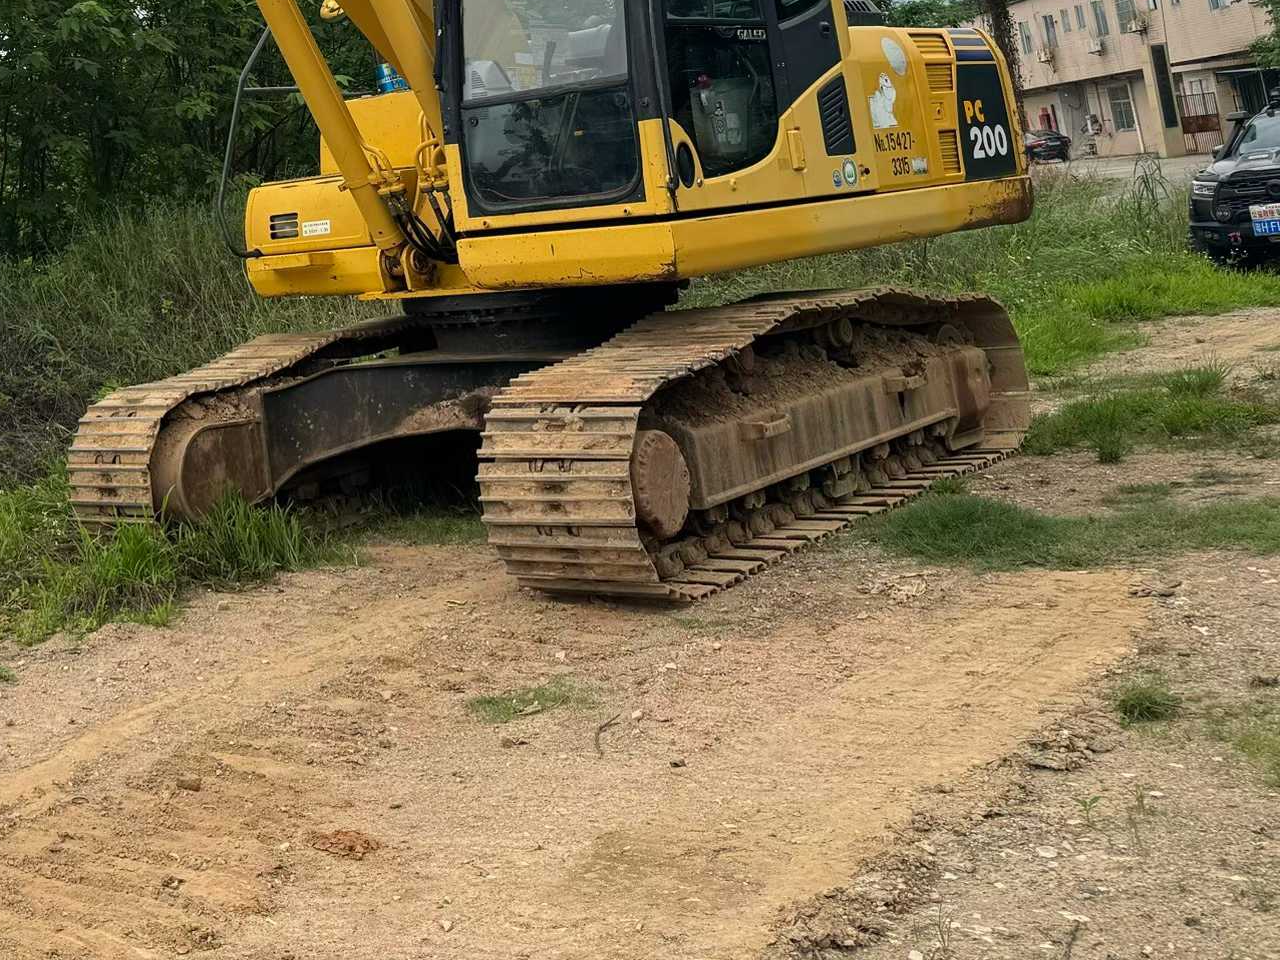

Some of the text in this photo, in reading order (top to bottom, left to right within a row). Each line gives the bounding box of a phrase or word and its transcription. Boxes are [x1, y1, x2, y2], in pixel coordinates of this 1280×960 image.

[963, 99, 985, 124] PC
[969, 124, 1008, 159] 200
[891, 156, 911, 176] 3315
